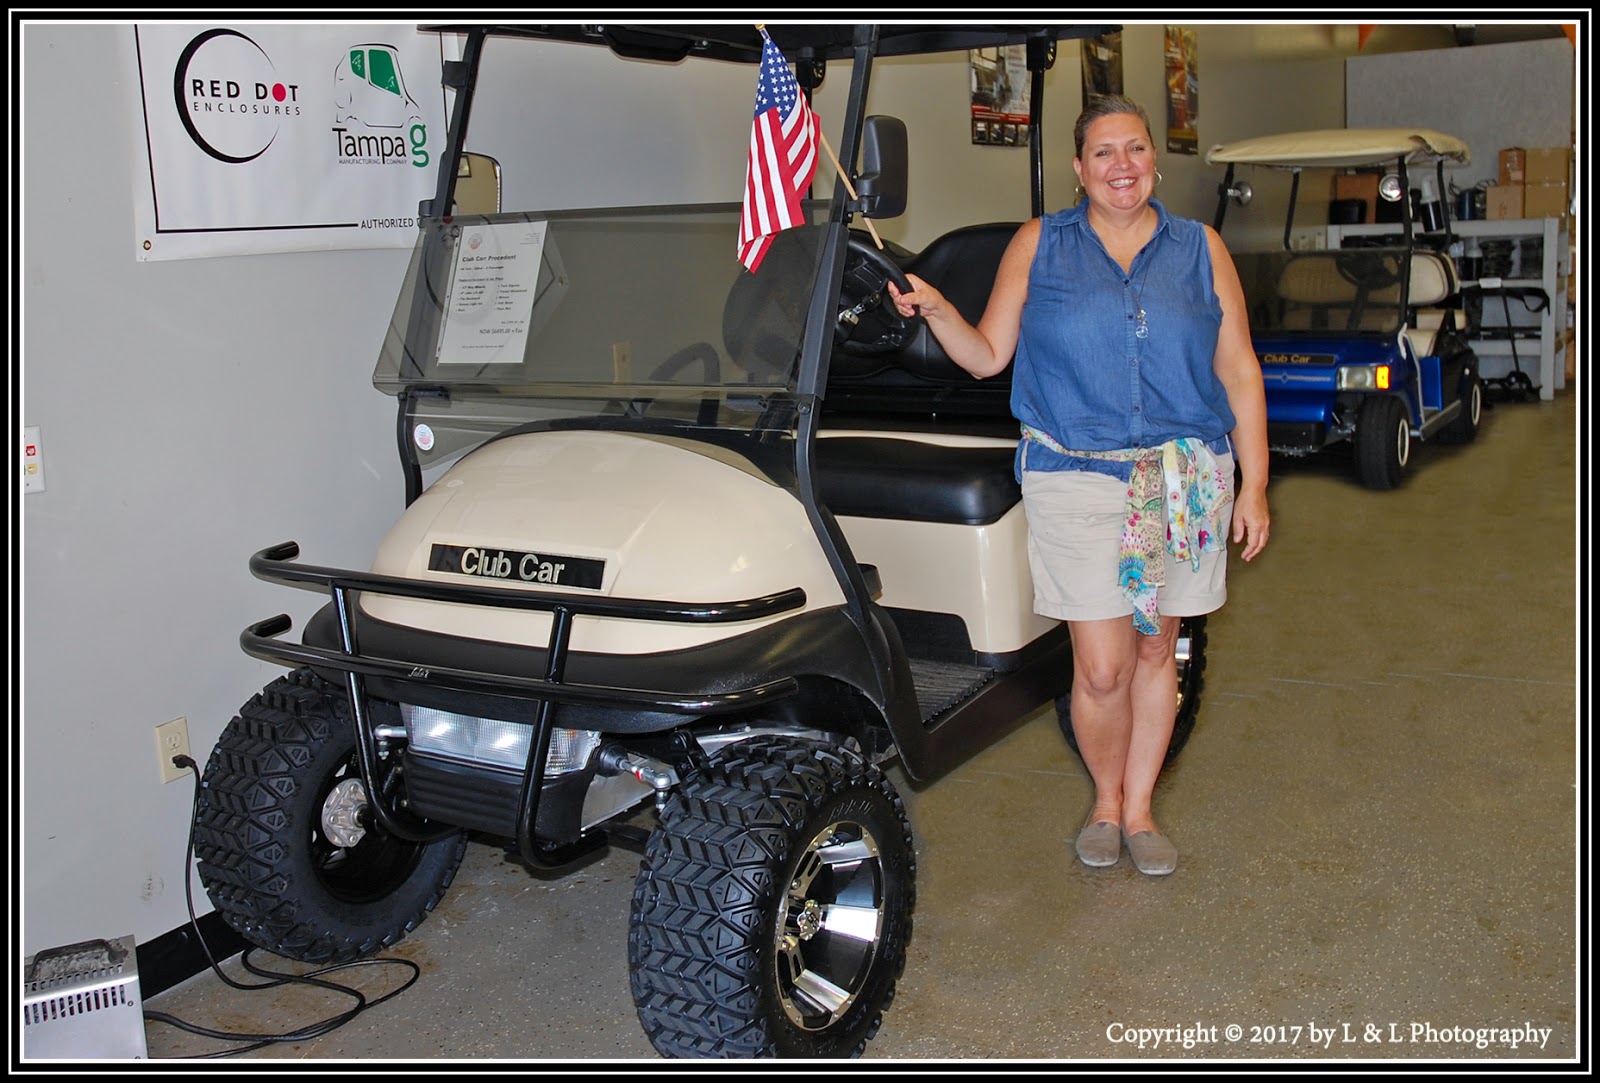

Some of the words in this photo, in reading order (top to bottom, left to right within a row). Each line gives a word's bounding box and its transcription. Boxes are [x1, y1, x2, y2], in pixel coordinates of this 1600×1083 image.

[192, 78, 240, 98] RED
[255, 82, 298, 102] DOT
[193, 101, 300, 116] ENCLOSURES
[332, 127, 406, 165] Tampa
[361, 217, 414, 229] AUTHORIZED
[1264, 353, 1288, 363] Club
[1290, 354, 1312, 364] Car
[461, 547, 512, 578] Club
[519, 553, 566, 584] Car
